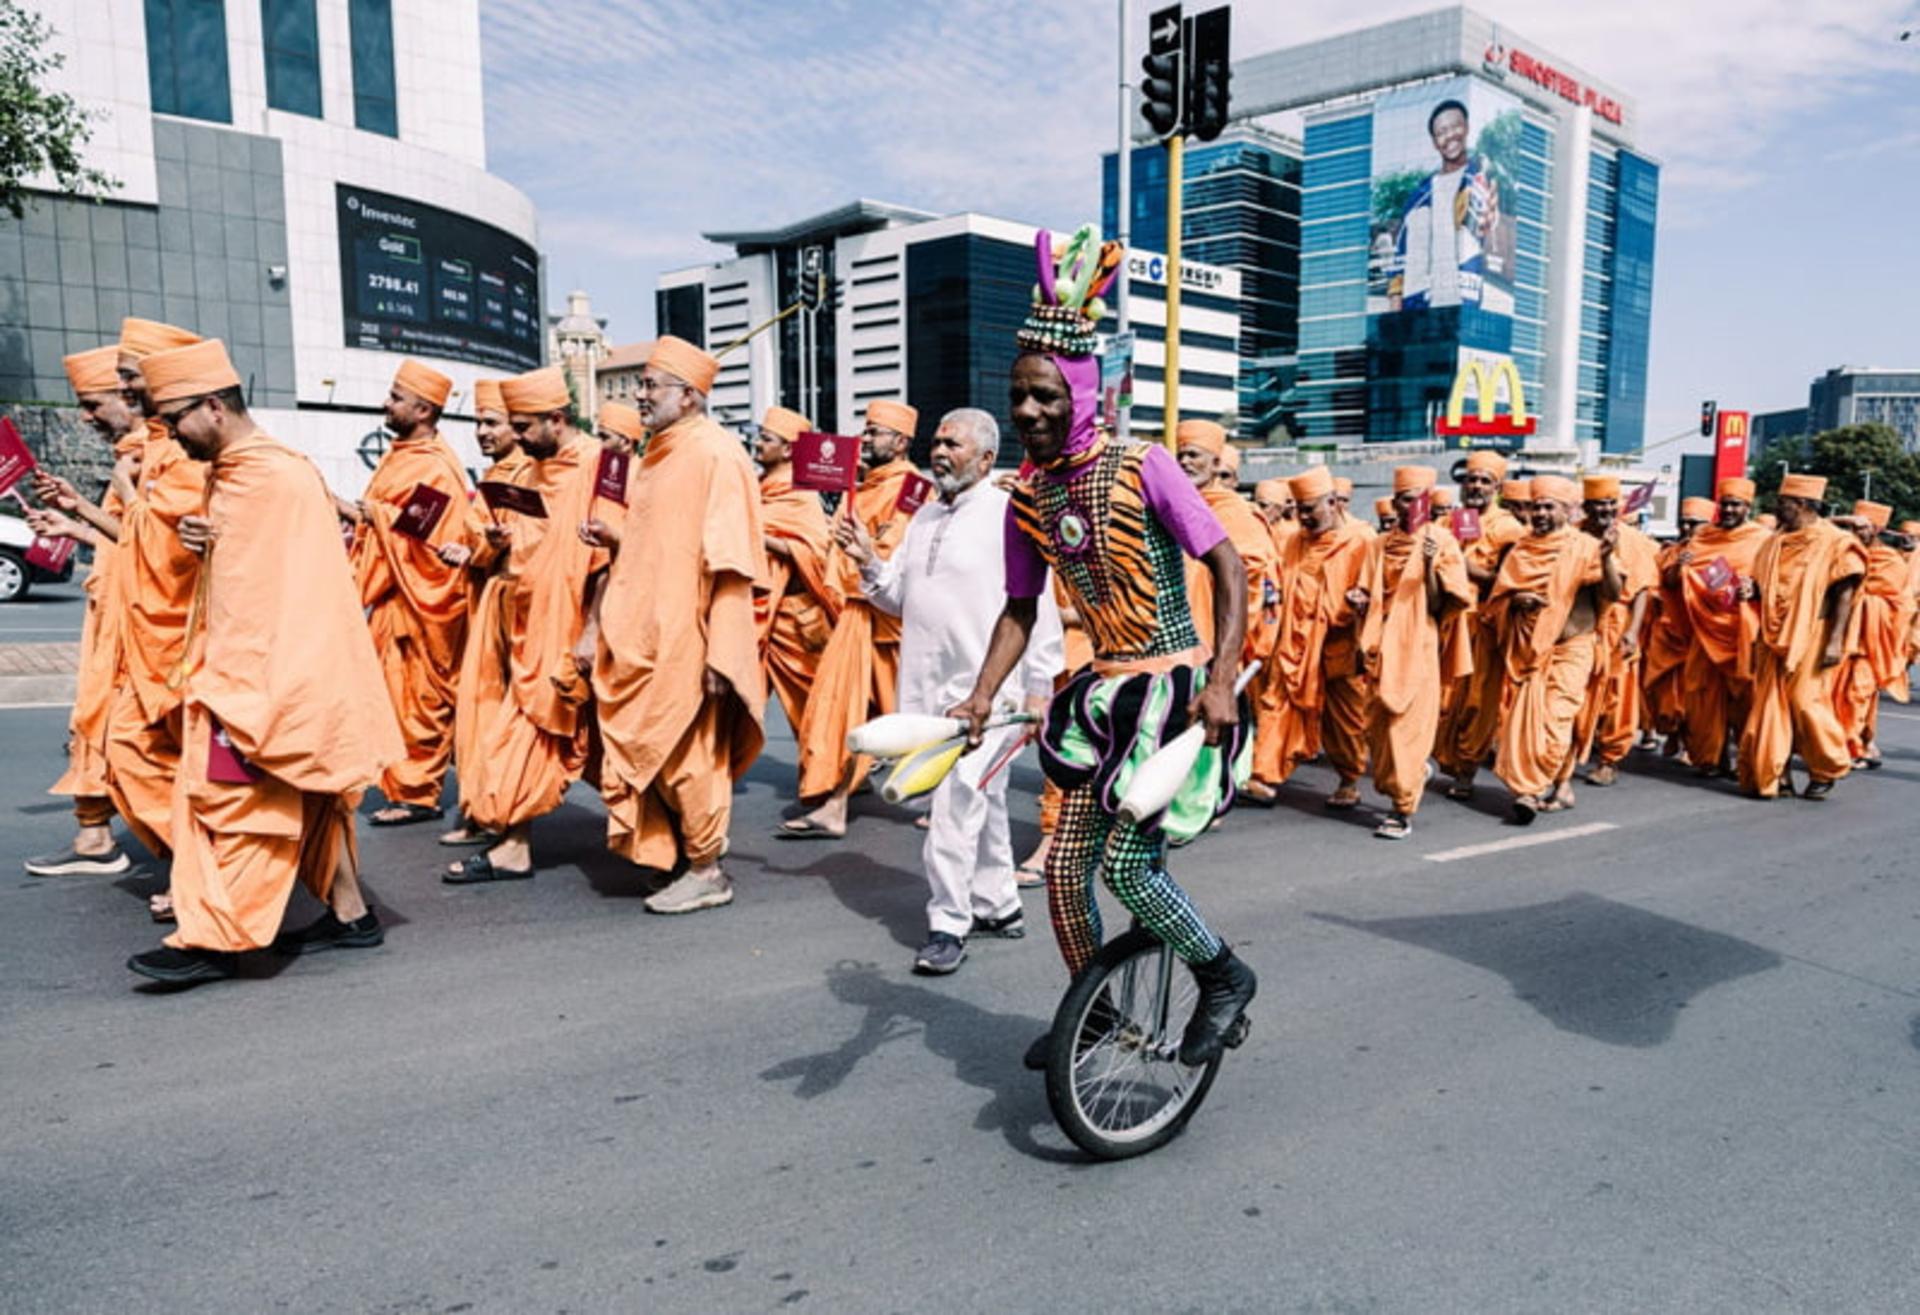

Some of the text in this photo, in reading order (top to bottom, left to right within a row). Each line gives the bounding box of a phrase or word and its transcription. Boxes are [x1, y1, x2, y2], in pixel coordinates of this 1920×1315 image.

[1509, 48, 1582, 106] SINOSTEEL
[1584, 86, 1622, 125] PLAZA
[361, 203, 416, 229] Investec
[378, 236, 405, 254] Gold
